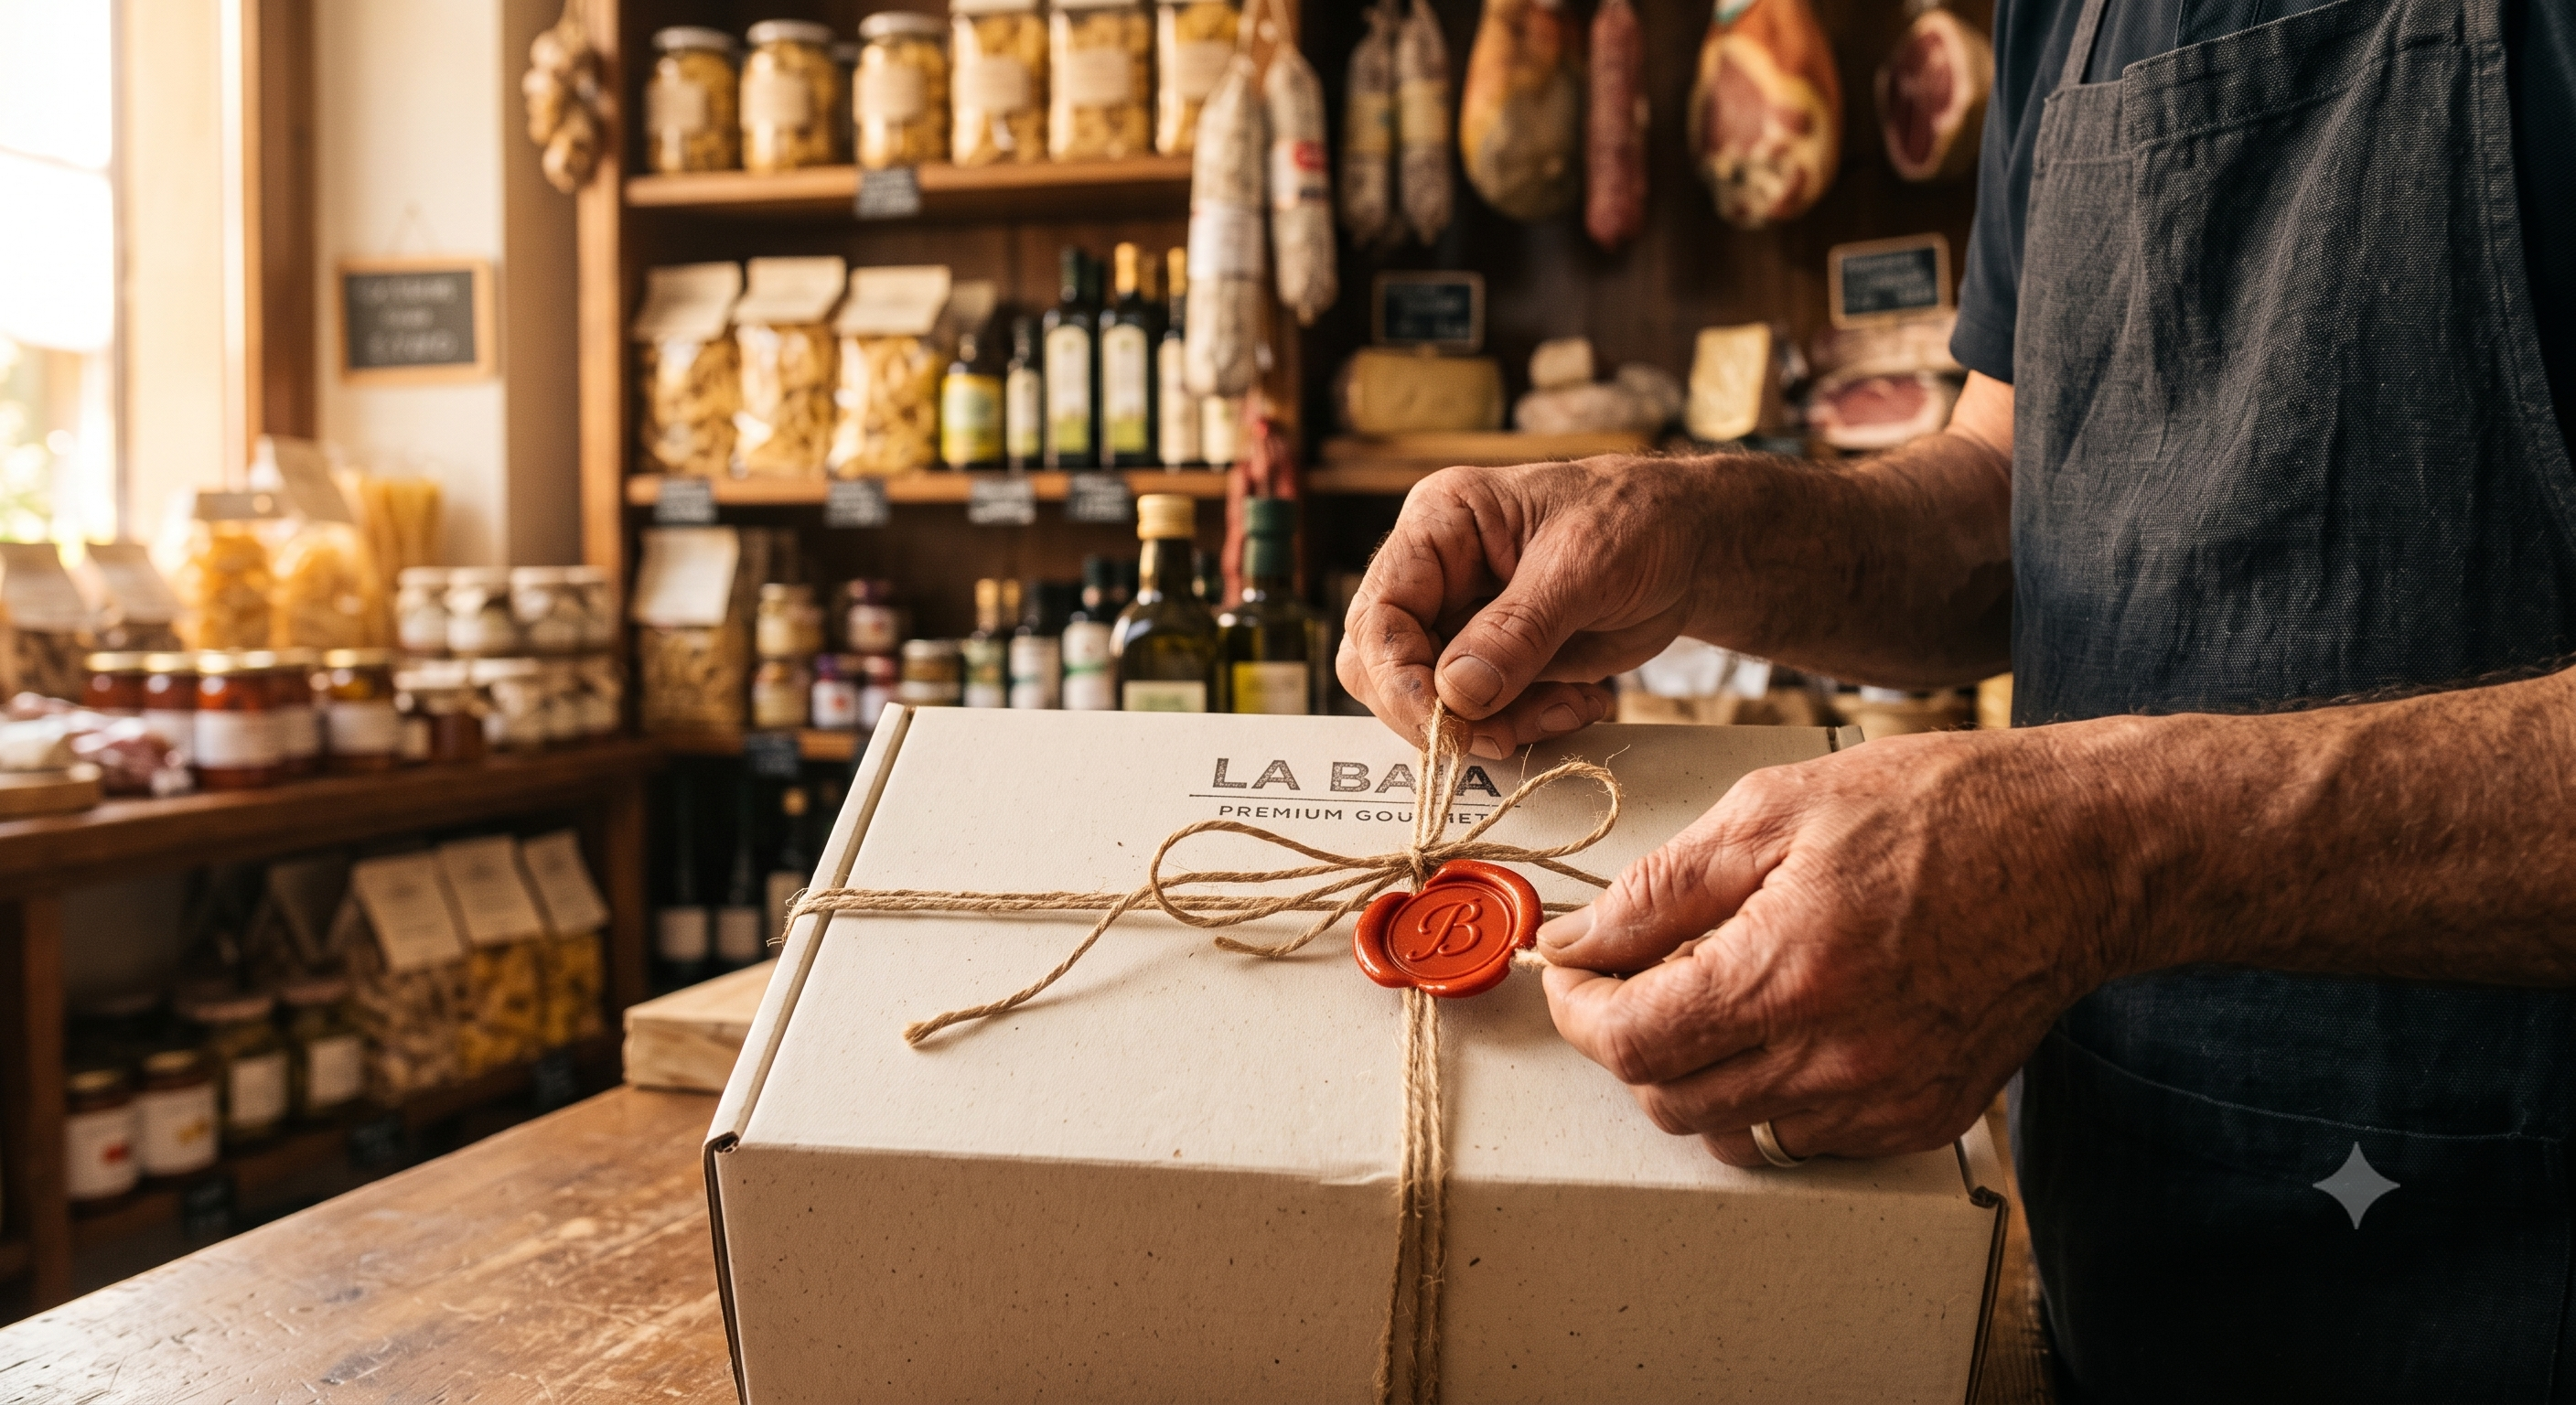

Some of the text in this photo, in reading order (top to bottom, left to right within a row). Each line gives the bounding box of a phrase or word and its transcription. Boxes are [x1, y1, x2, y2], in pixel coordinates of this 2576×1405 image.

[1212, 757, 1301, 791] LA
[1218, 805, 1489, 824] PREMIUM GOUET
[1406, 897, 1483, 962] B
